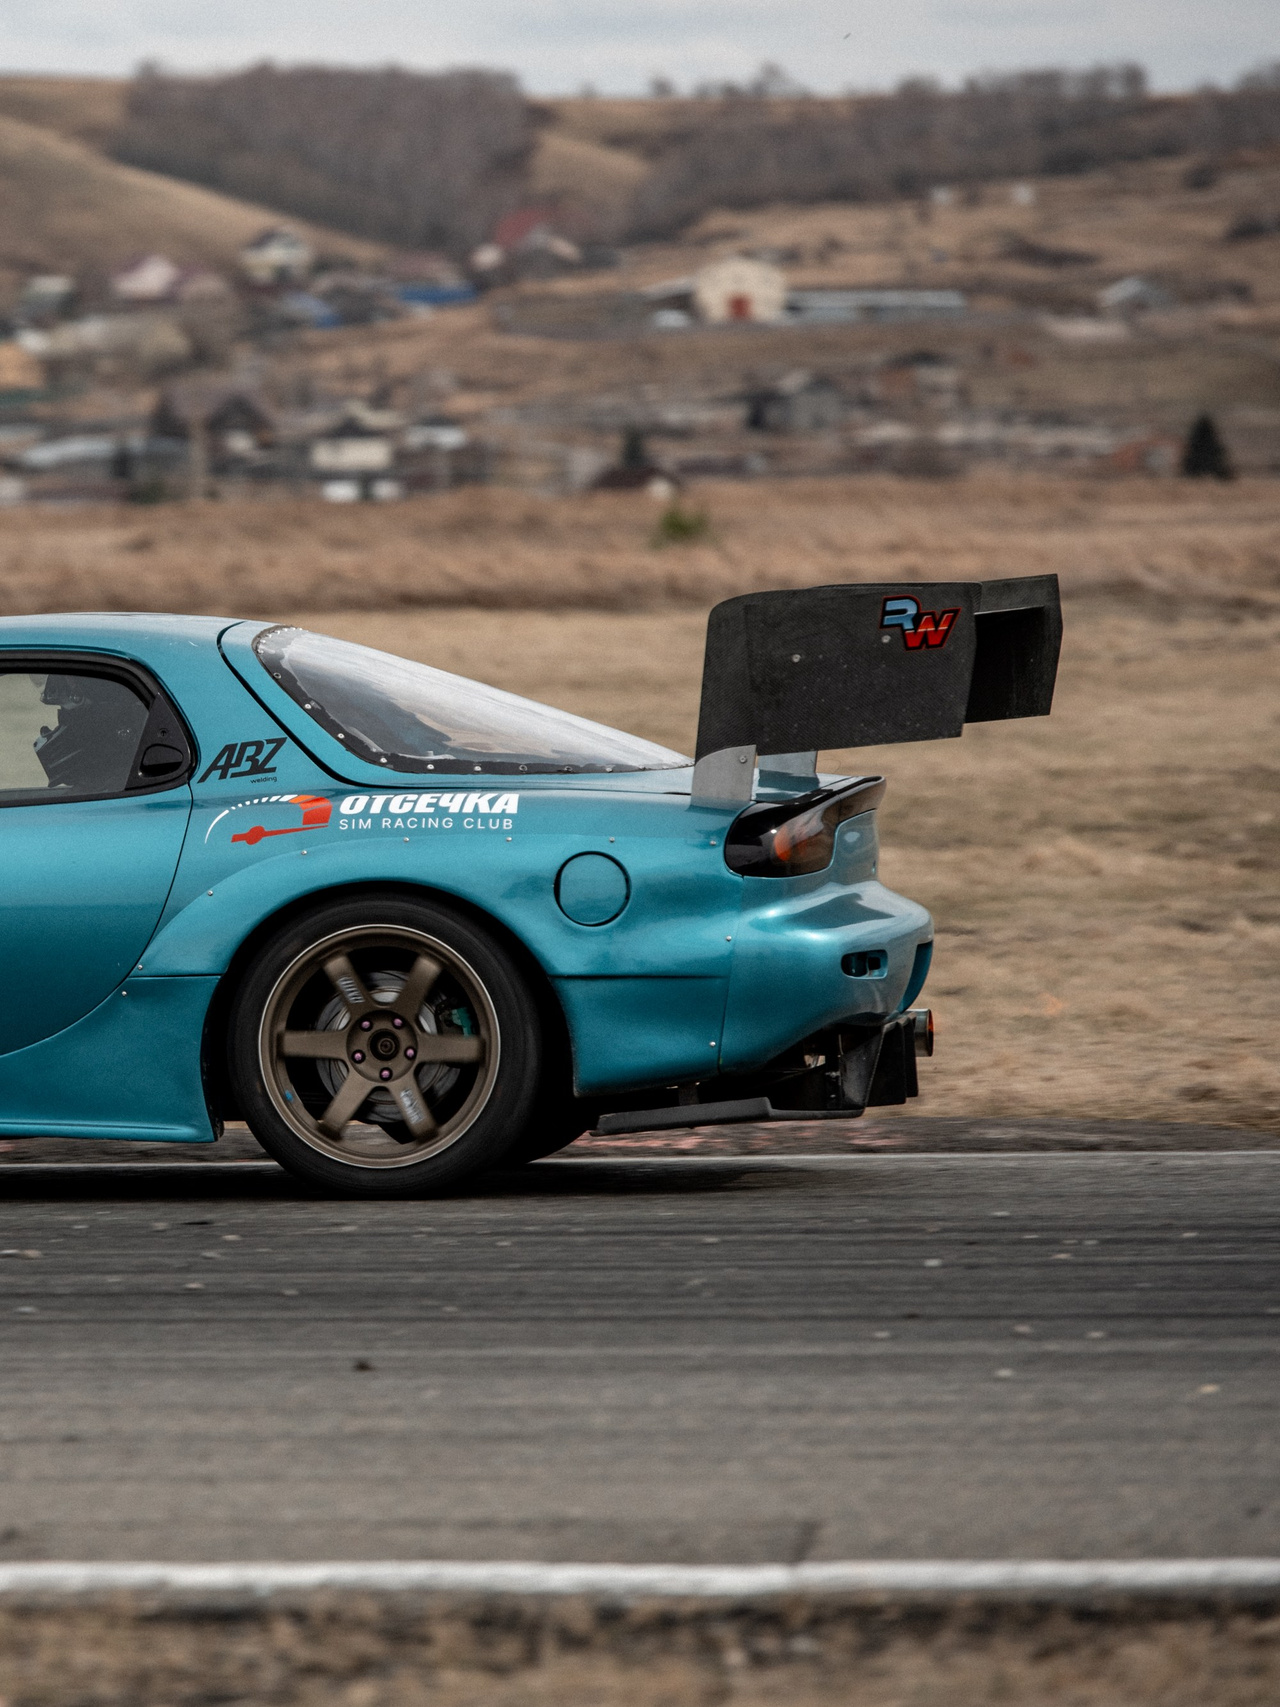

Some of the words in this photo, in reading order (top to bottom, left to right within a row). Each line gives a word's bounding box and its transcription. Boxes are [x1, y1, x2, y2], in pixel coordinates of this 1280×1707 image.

[881, 595, 960, 650] RW
[197, 737, 288, 784] ABZ
[250, 776, 278, 785] welding
[339, 793, 520, 815] ОТСЕЧКА
[339, 818, 372, 830] SIM
[382, 817, 453, 829] RACING
[463, 818, 513, 830] CLUB
